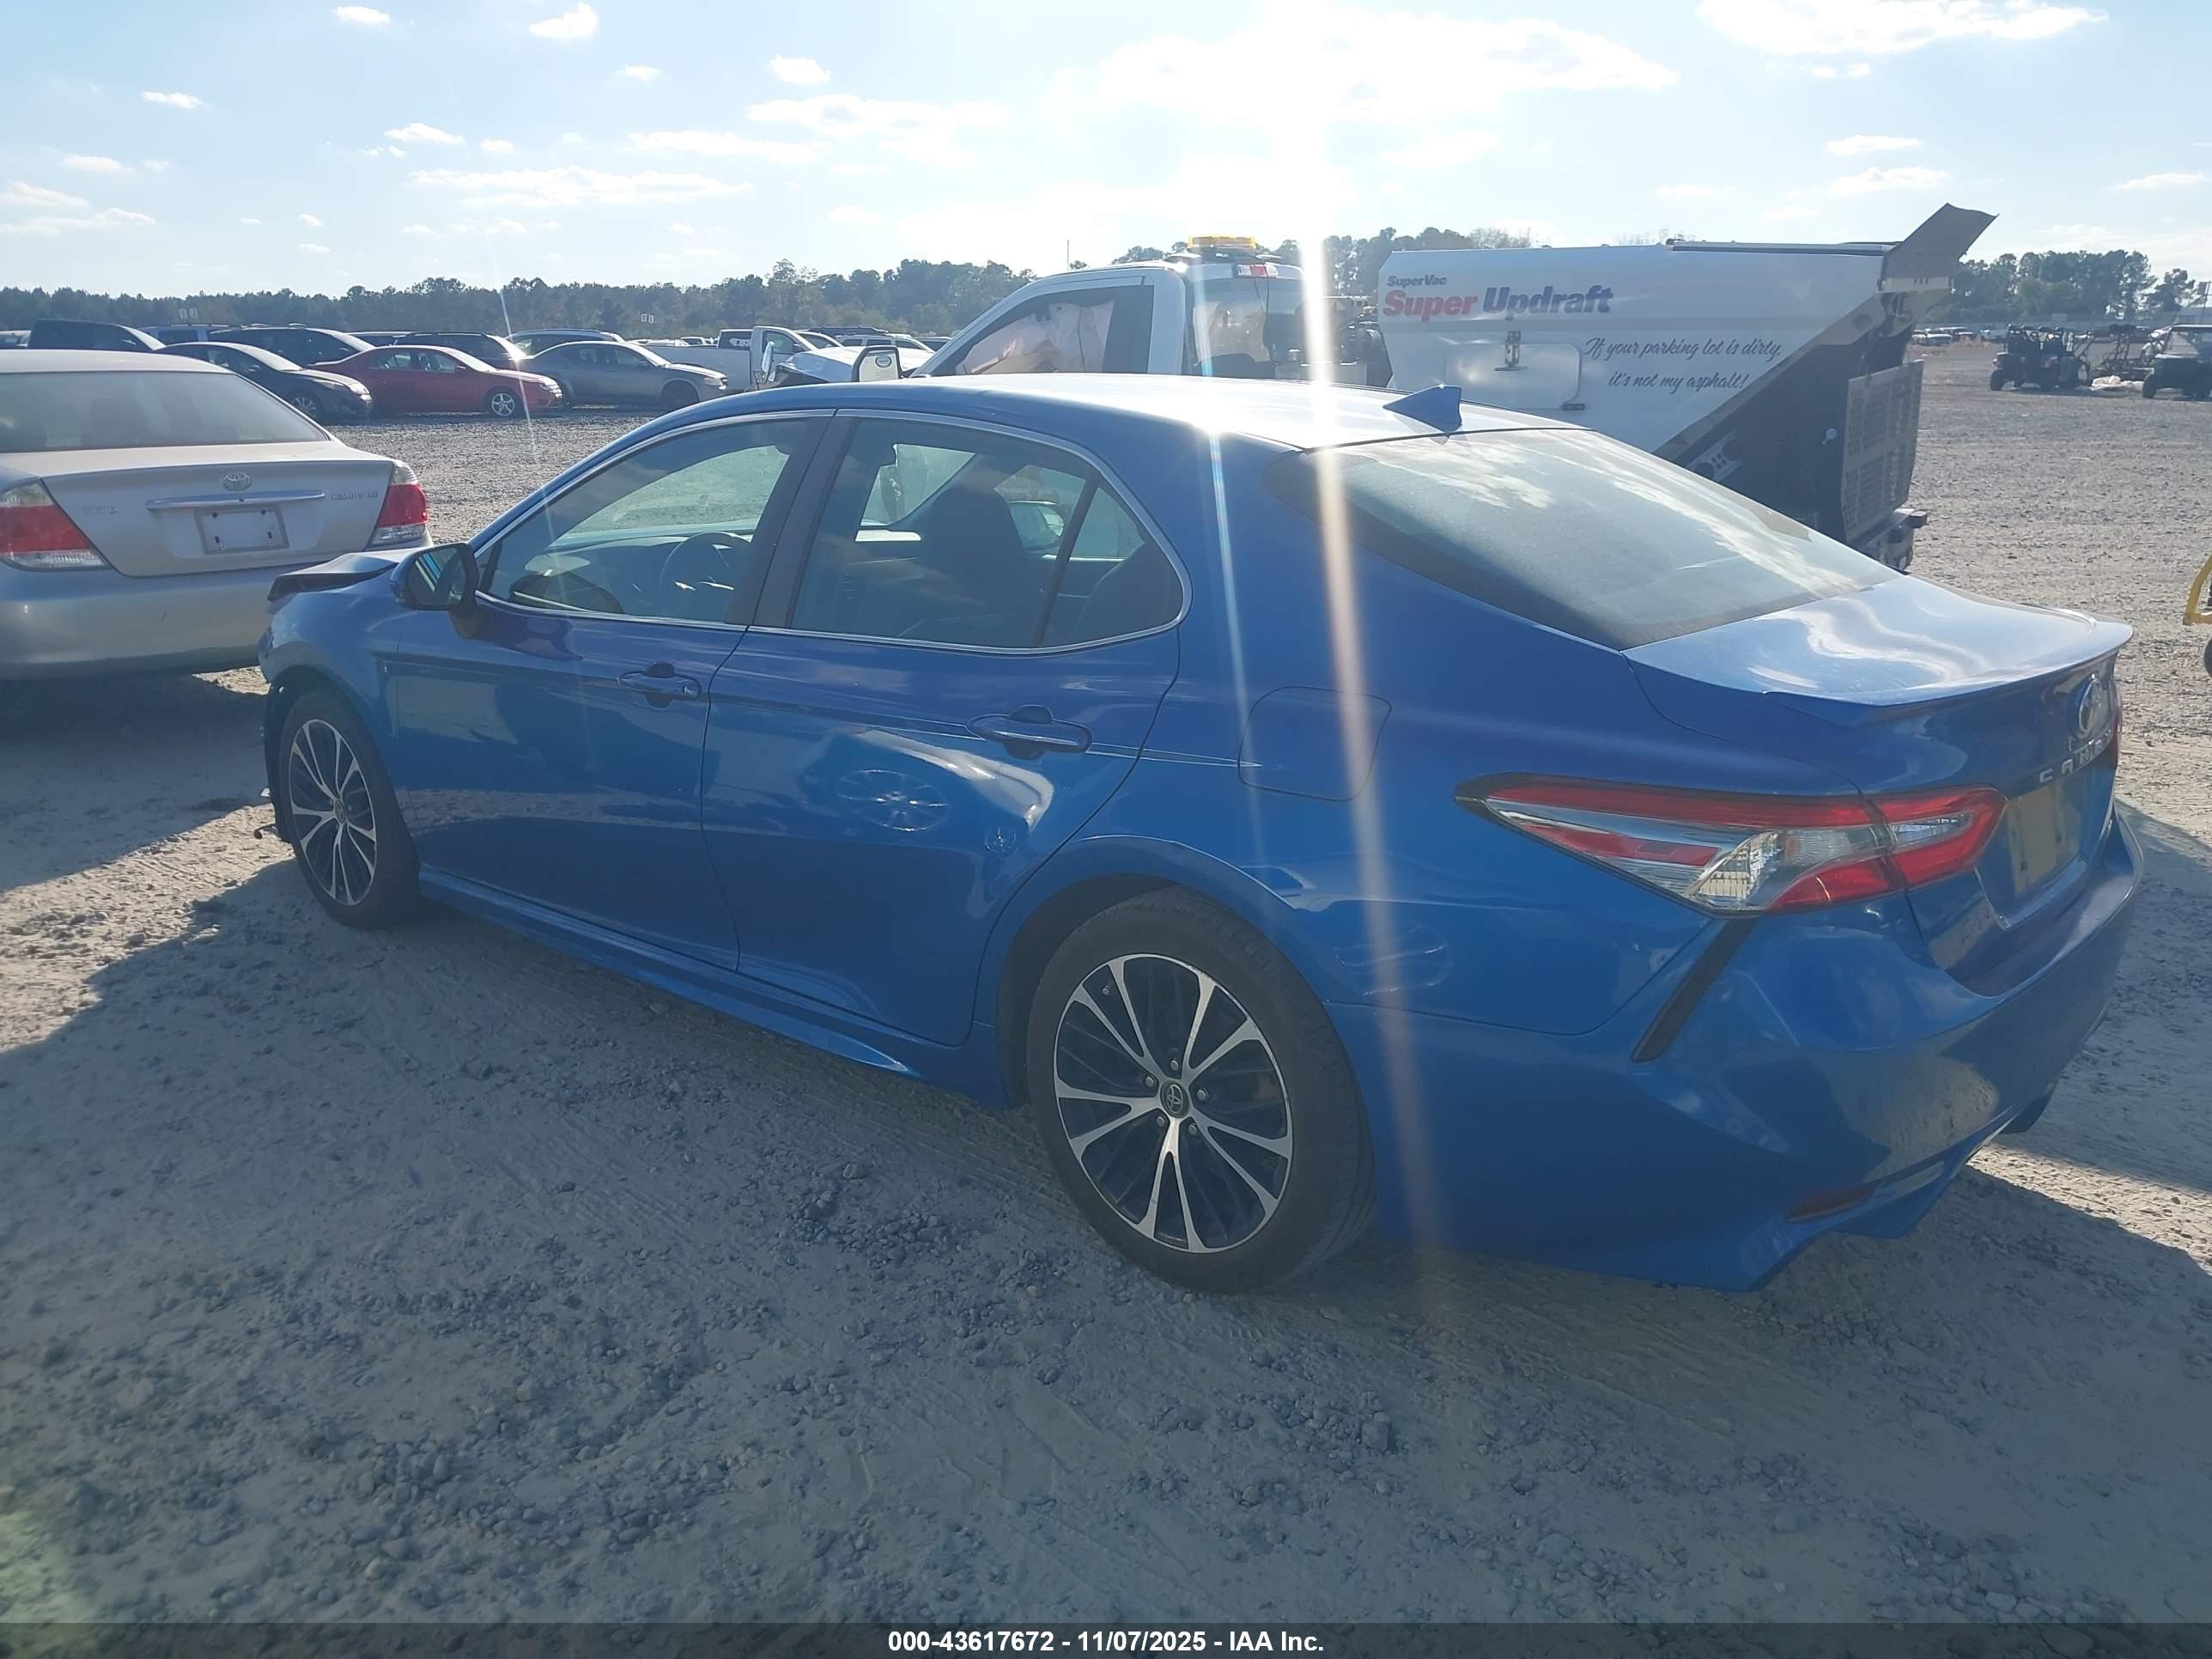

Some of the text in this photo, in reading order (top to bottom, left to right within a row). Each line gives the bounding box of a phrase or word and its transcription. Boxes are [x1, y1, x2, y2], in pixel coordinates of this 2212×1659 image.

[1387, 274, 1447, 289] SuperVac
[1382, 284, 1613, 323] Super Updraft
[1583, 337, 1782, 363] If your parking lot is dirty,
[1607, 371, 1750, 395] it's not my asphalt!
